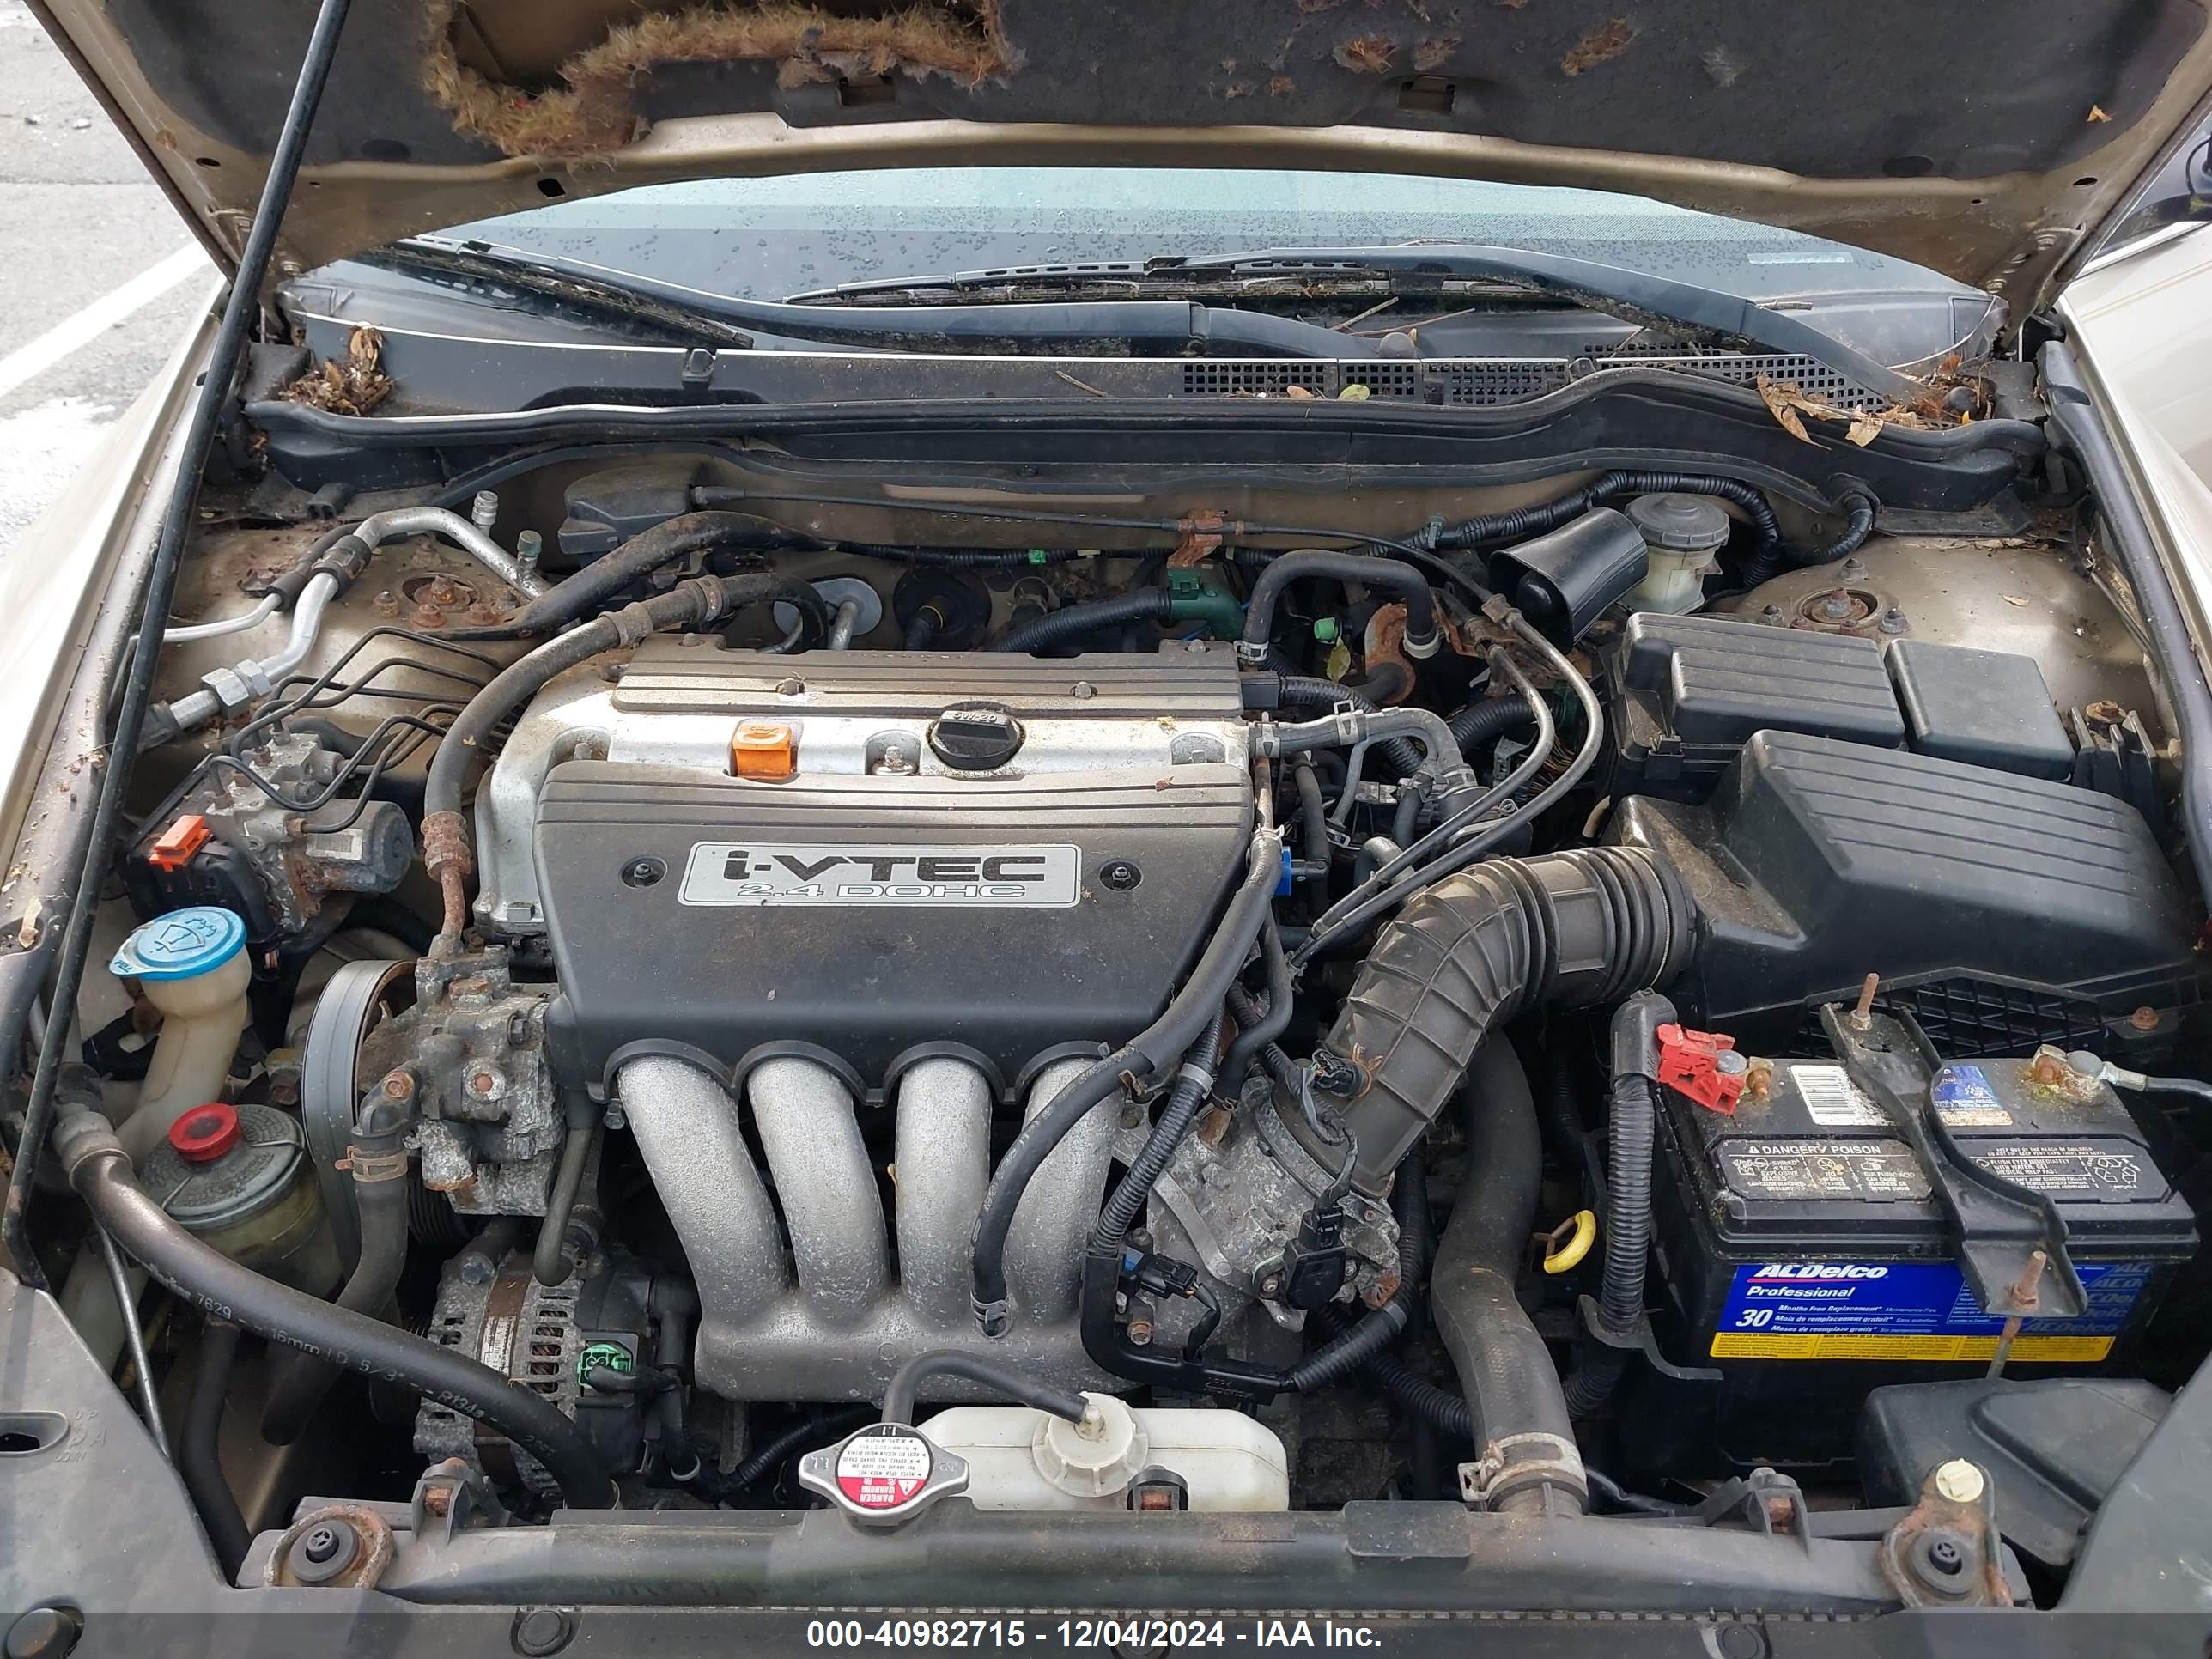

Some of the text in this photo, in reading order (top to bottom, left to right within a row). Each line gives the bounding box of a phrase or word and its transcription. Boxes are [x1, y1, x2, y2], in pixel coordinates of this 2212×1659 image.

[723, 850, 1045, 882] i-VTEC
[738, 883, 1025, 898] 2.4 DOHC
[1831, 1146, 1882, 1154] POISON
[1753, 1264, 1889, 1279] ACDelco
[1746, 1285, 1856, 1297] Professional
[197, 1292, 232, 1320] 7629
[1735, 1309, 1774, 1328] 30
[860, 1493, 895, 1503] DANGER
